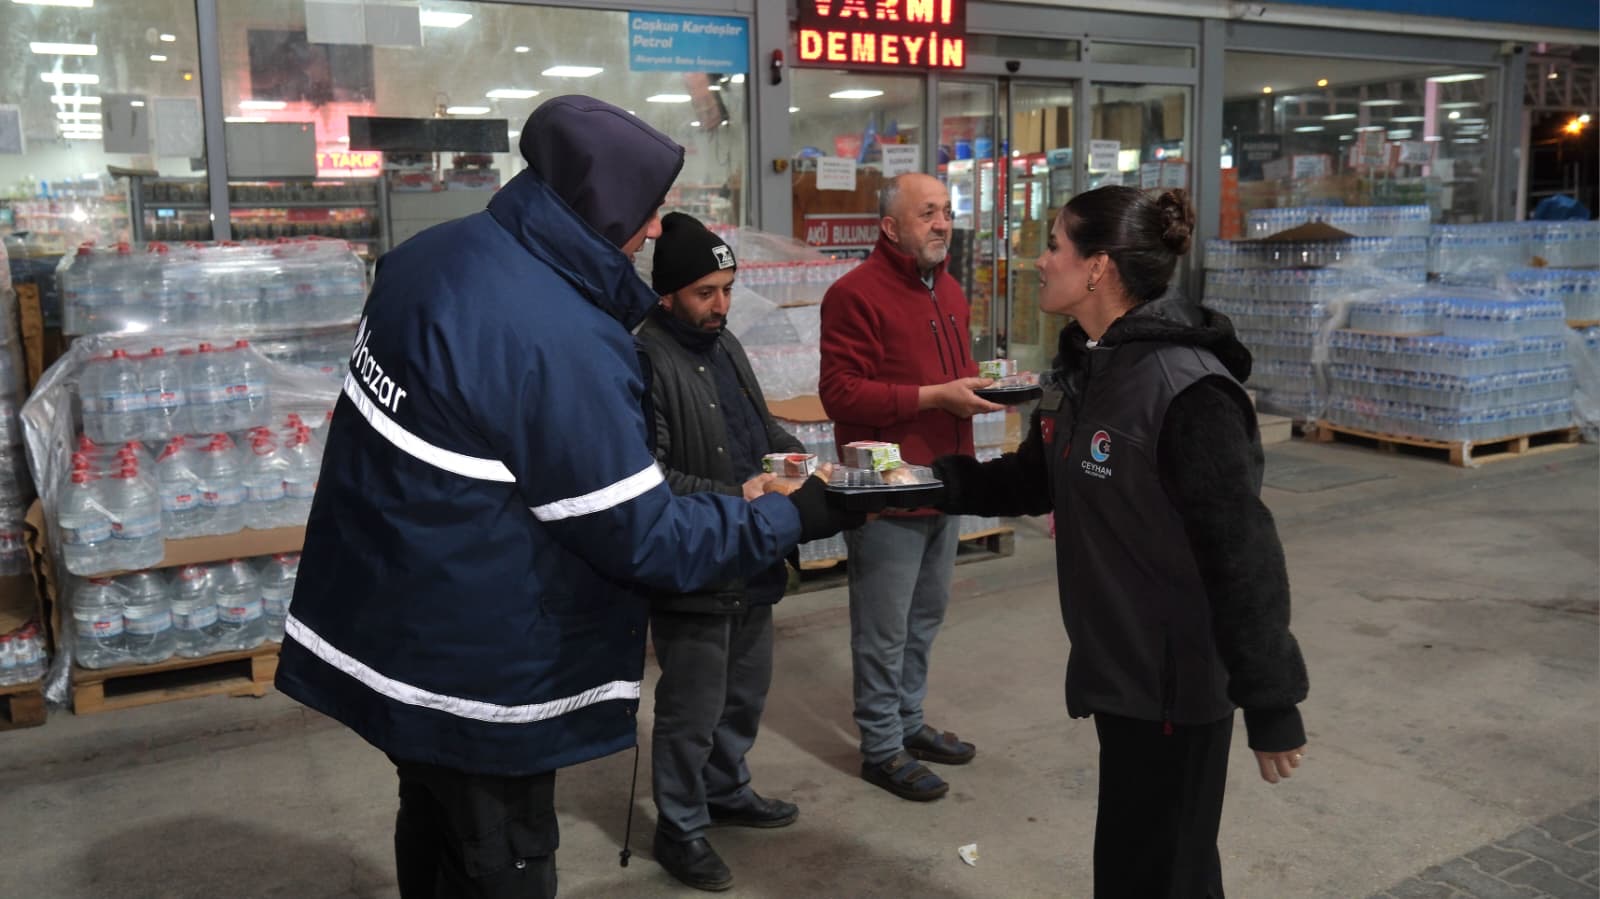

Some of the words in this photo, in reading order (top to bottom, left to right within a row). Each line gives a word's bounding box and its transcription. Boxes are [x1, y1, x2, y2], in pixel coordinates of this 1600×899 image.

[633, 34, 673, 48] Petrol
[800, 30, 963, 67] DEMEYİN
[807, 221, 829, 243] AKÜ
[833, 225, 880, 243] BULUNUR
[1081, 460, 1112, 477] CEYHAN
